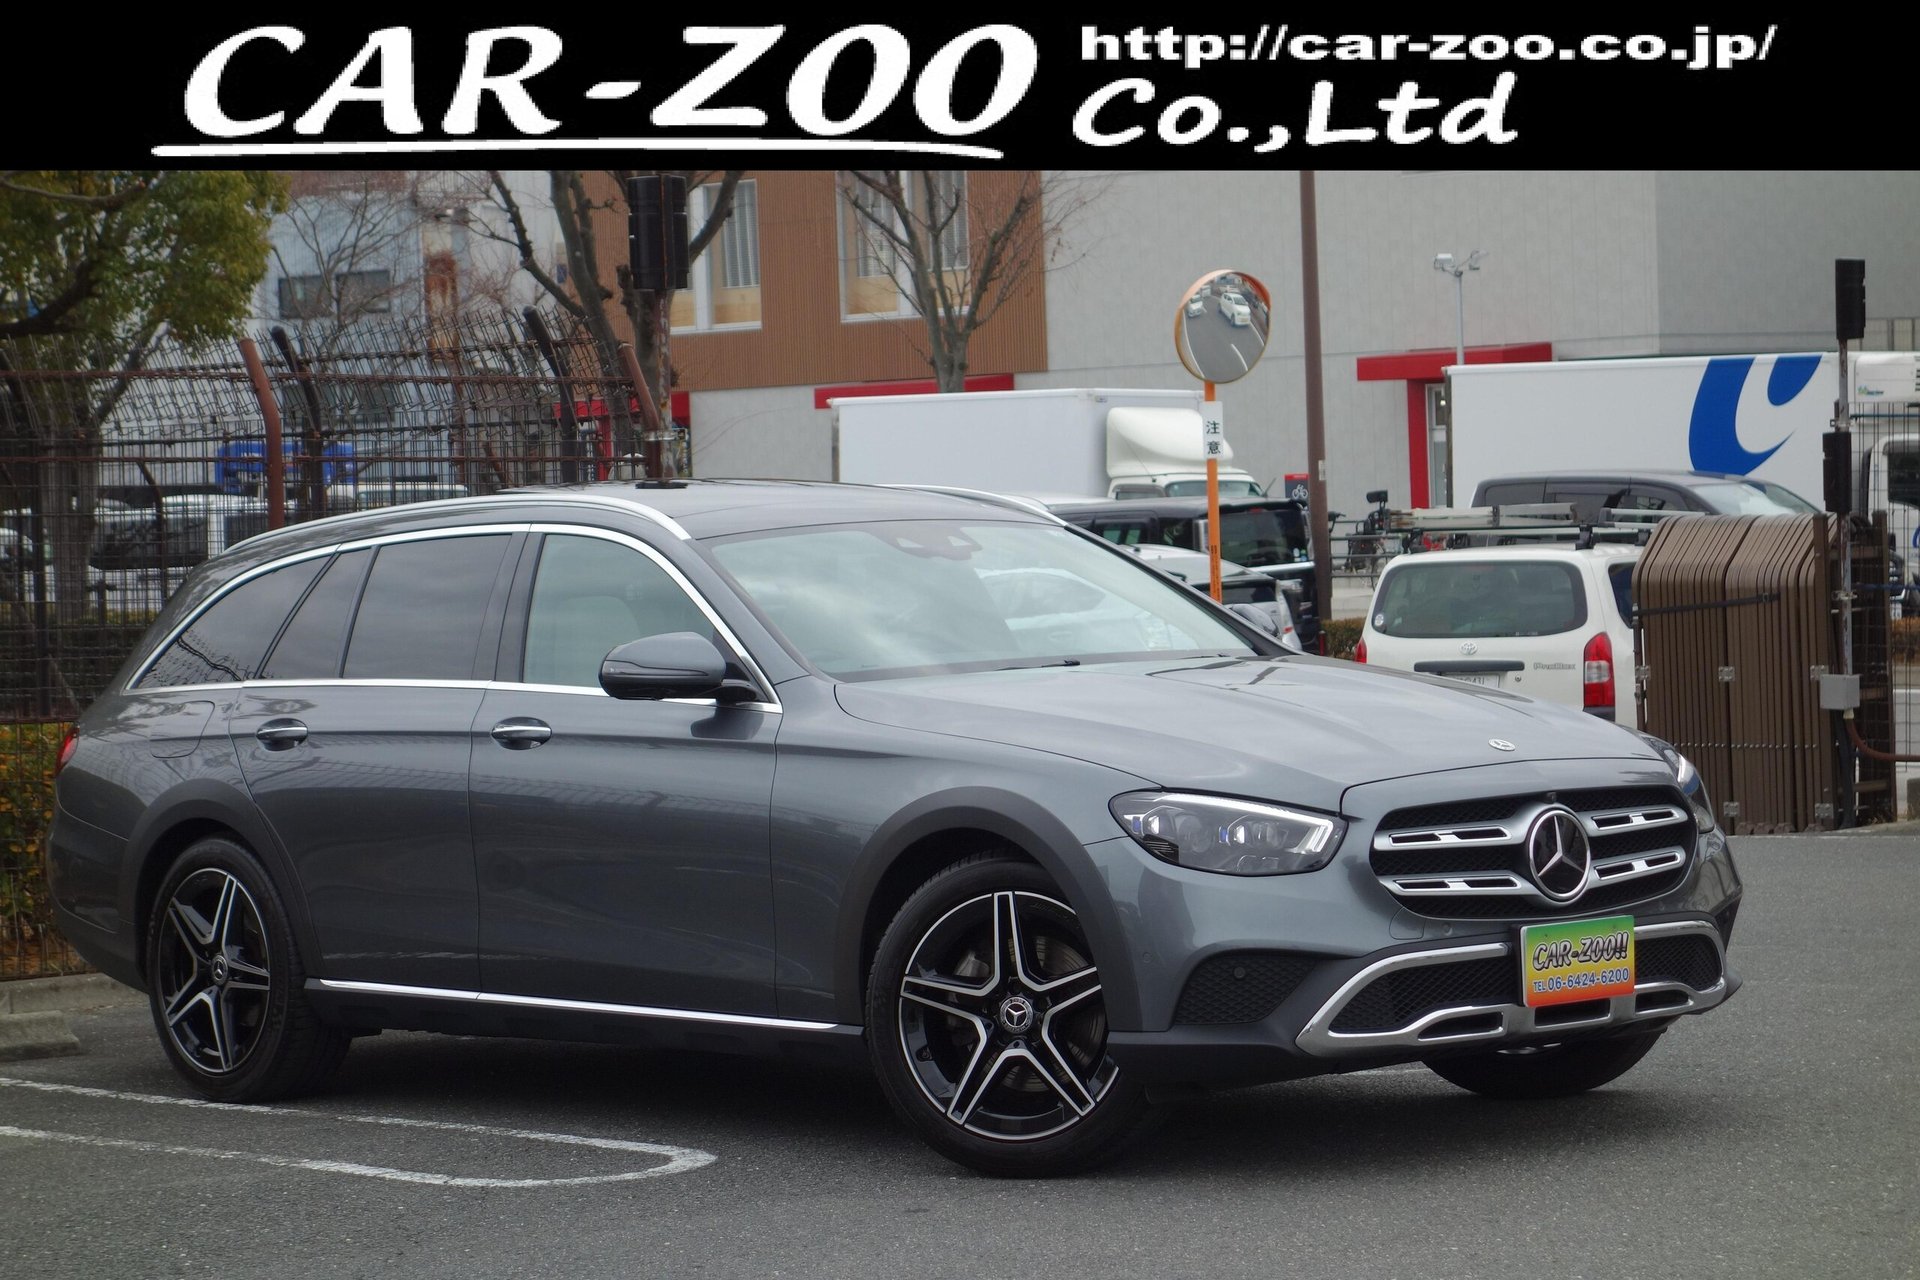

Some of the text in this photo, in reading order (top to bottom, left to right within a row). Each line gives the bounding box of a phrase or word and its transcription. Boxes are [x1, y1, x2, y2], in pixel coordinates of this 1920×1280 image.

[1205, 420, 1221, 455] 注意
[1532, 931, 1629, 971] CAR-ZOO!!
[1533, 967, 1629, 992] TEL 06-6424-6200
